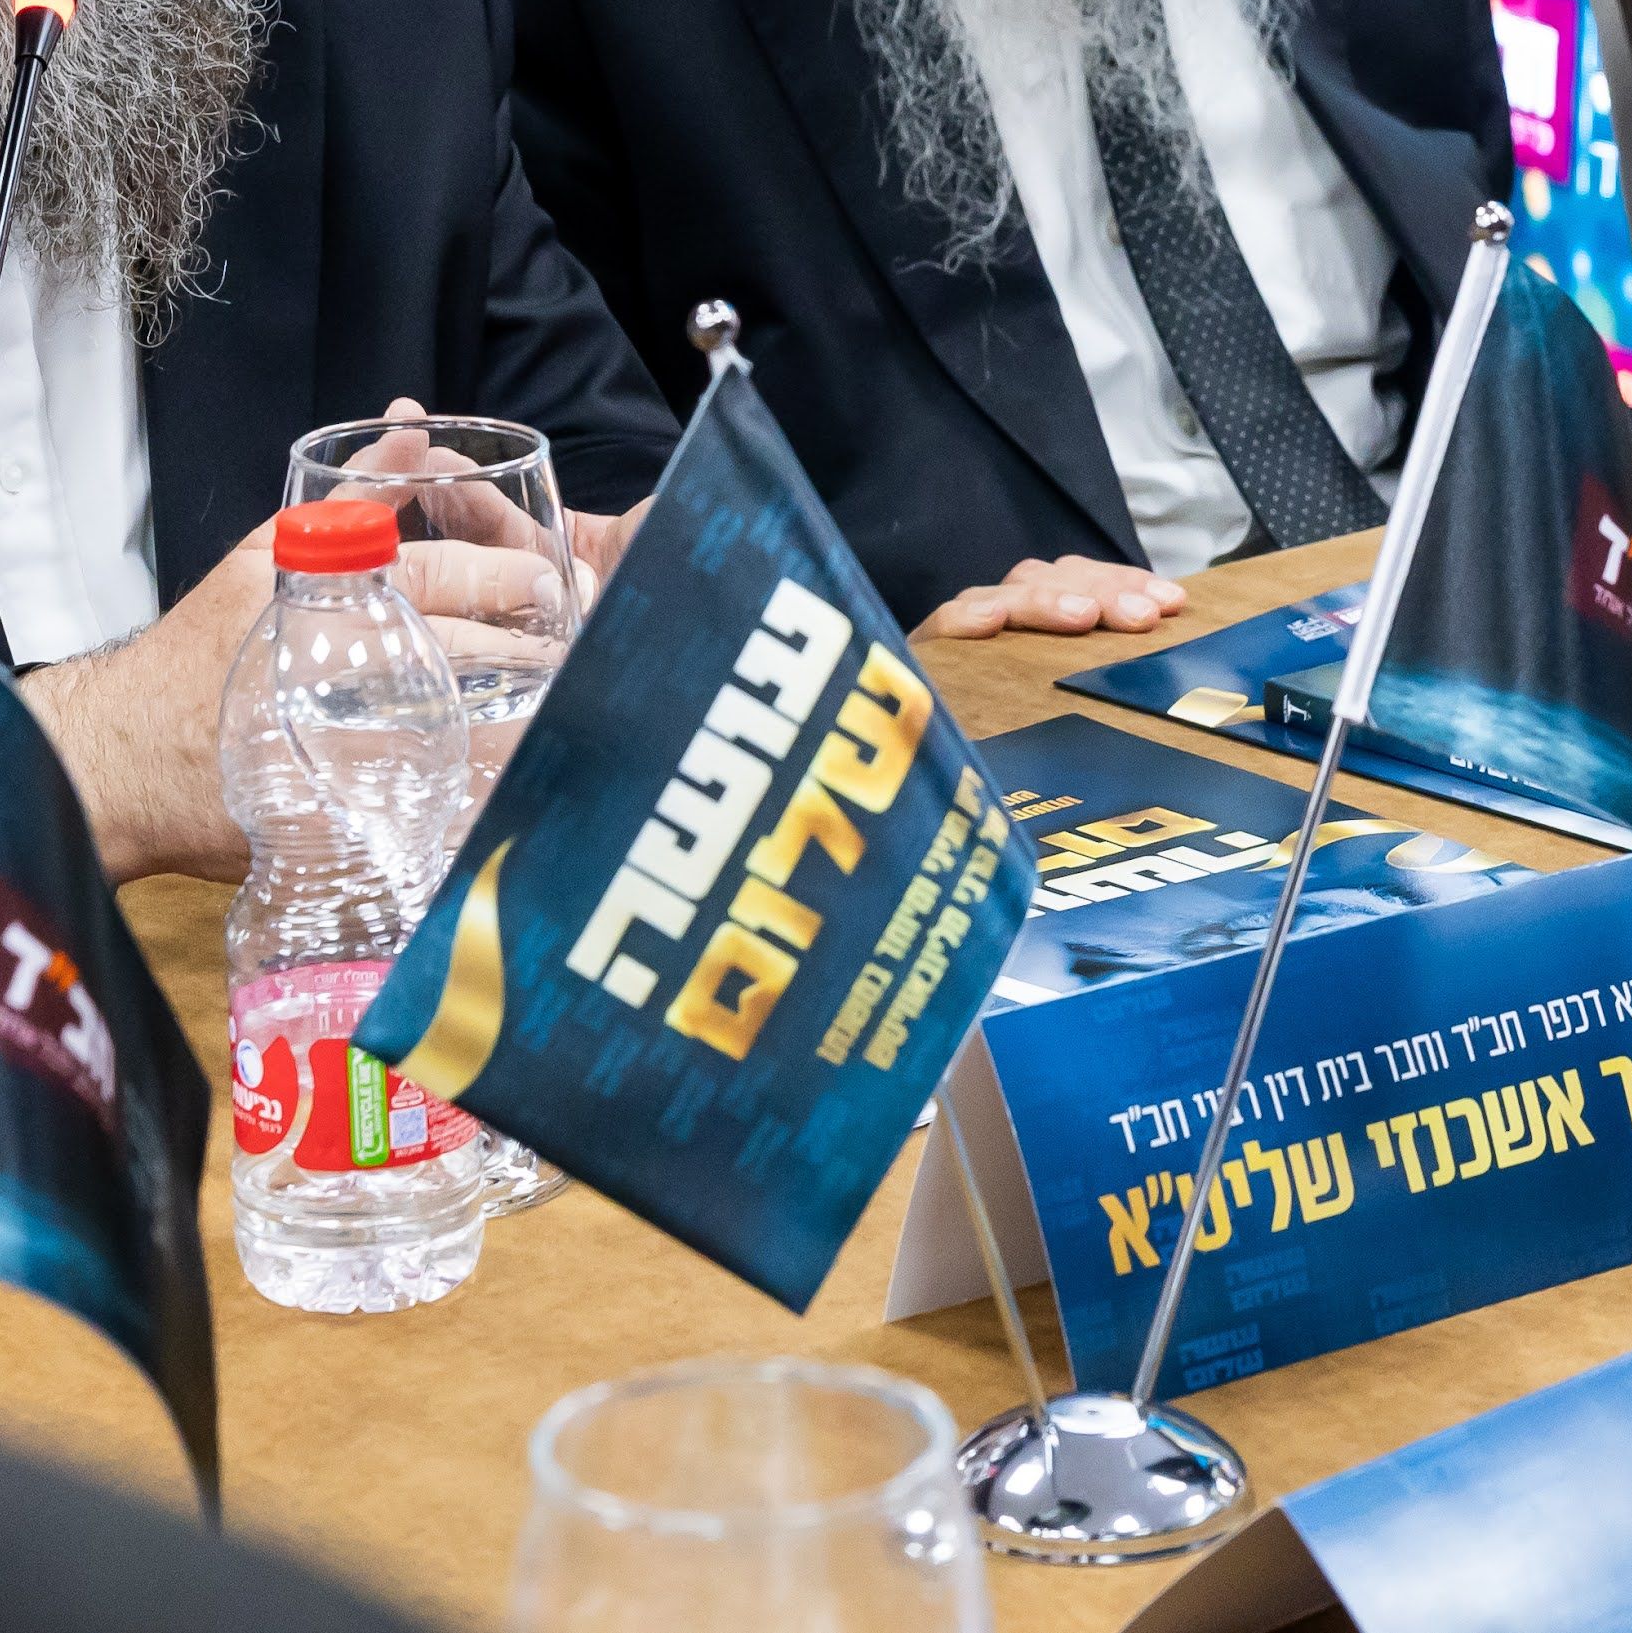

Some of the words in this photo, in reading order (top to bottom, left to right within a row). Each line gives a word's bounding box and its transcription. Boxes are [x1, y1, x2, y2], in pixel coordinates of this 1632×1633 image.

[565, 577, 853, 1010] עושה
[664, 643, 935, 1061] שלום
[1027, 831, 1278, 919] ושה
[1450, 1010, 1526, 1063] חב"ד
[1529, 988, 1606, 1042] דכפר
[1316, 1051, 1373, 1102] בית
[1374, 1029, 1450, 1083] וחבר
[1264, 1066, 1311, 1122] דין
[1109, 1098, 1191, 1154] חב"ד
[1366, 1068, 1596, 1194] אשכנזי
[1098, 1132, 1355, 1277] שליט"א
